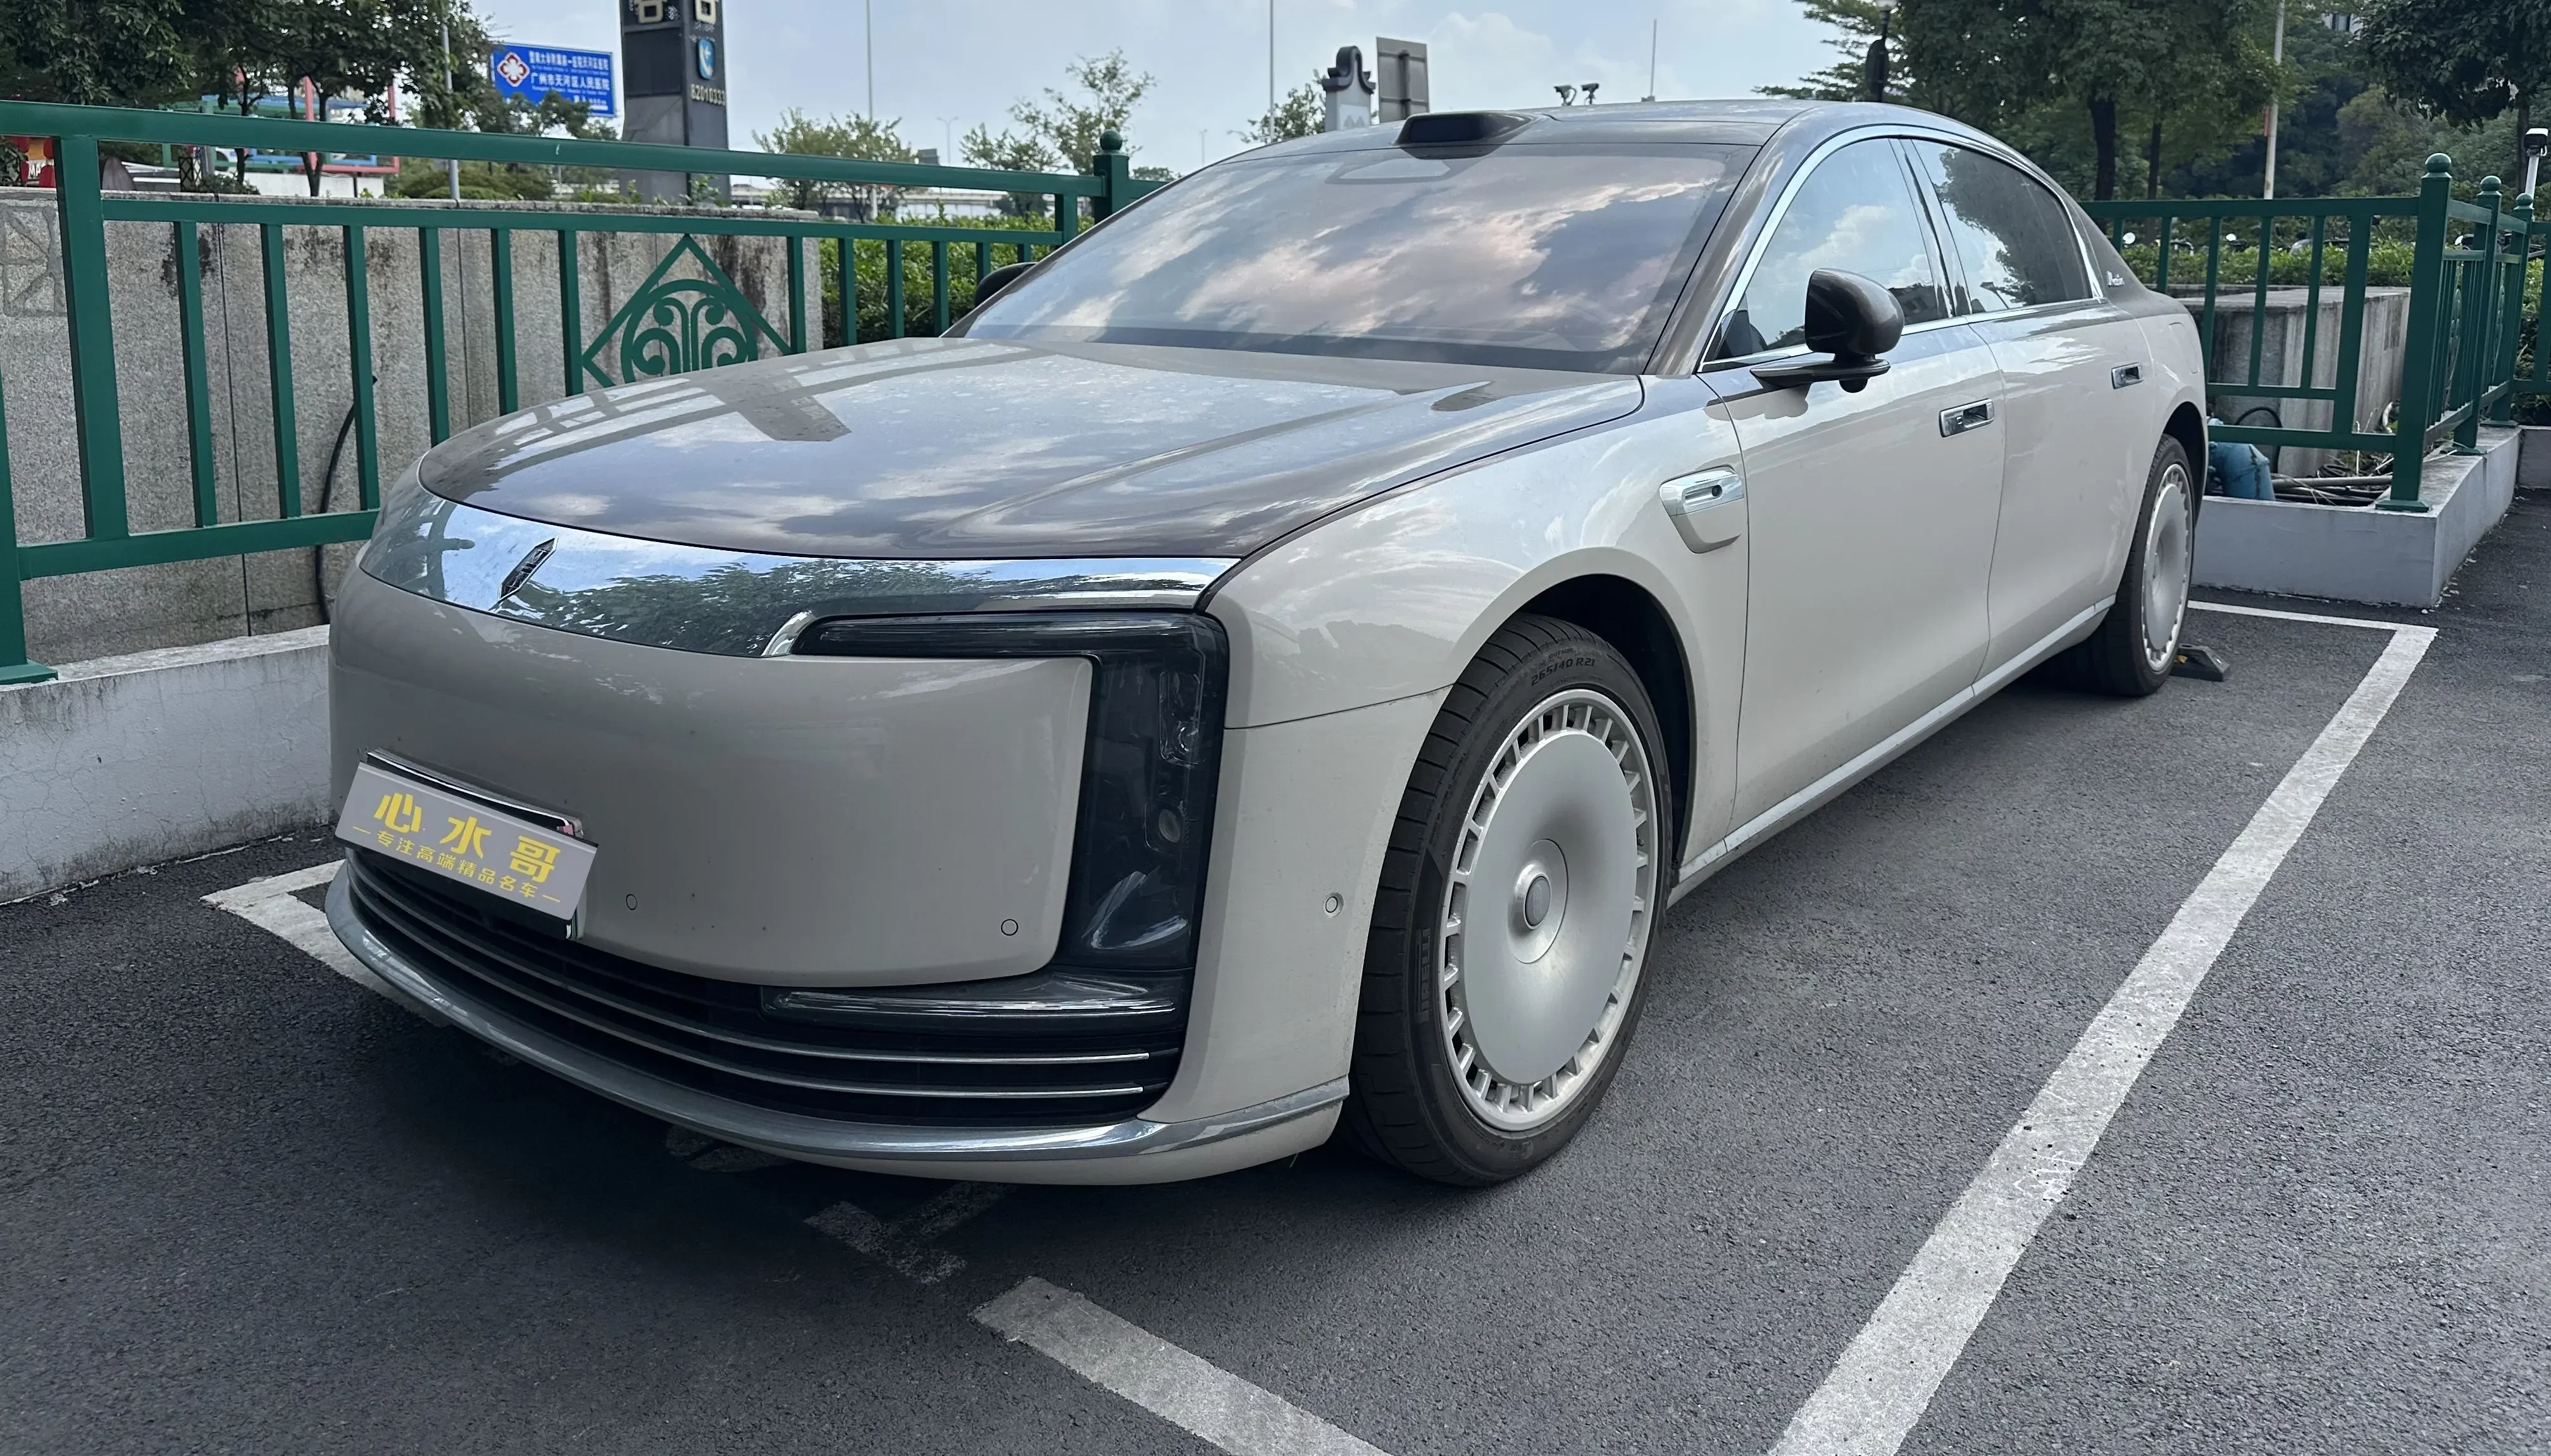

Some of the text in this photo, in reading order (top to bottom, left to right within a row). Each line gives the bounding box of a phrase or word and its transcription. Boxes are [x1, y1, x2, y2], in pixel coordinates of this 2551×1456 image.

[530, 72, 611, 91] 广州市天河区人民医院
[690, 83, 726, 106] 82010333
[1530, 658, 1574, 687] 265/40
[1575, 657, 1596, 667] R21
[373, 792, 562, 884] 心水哥
[376, 829, 539, 899] 专注高端精品名车
[1413, 927, 1431, 1024] PIRELLI
